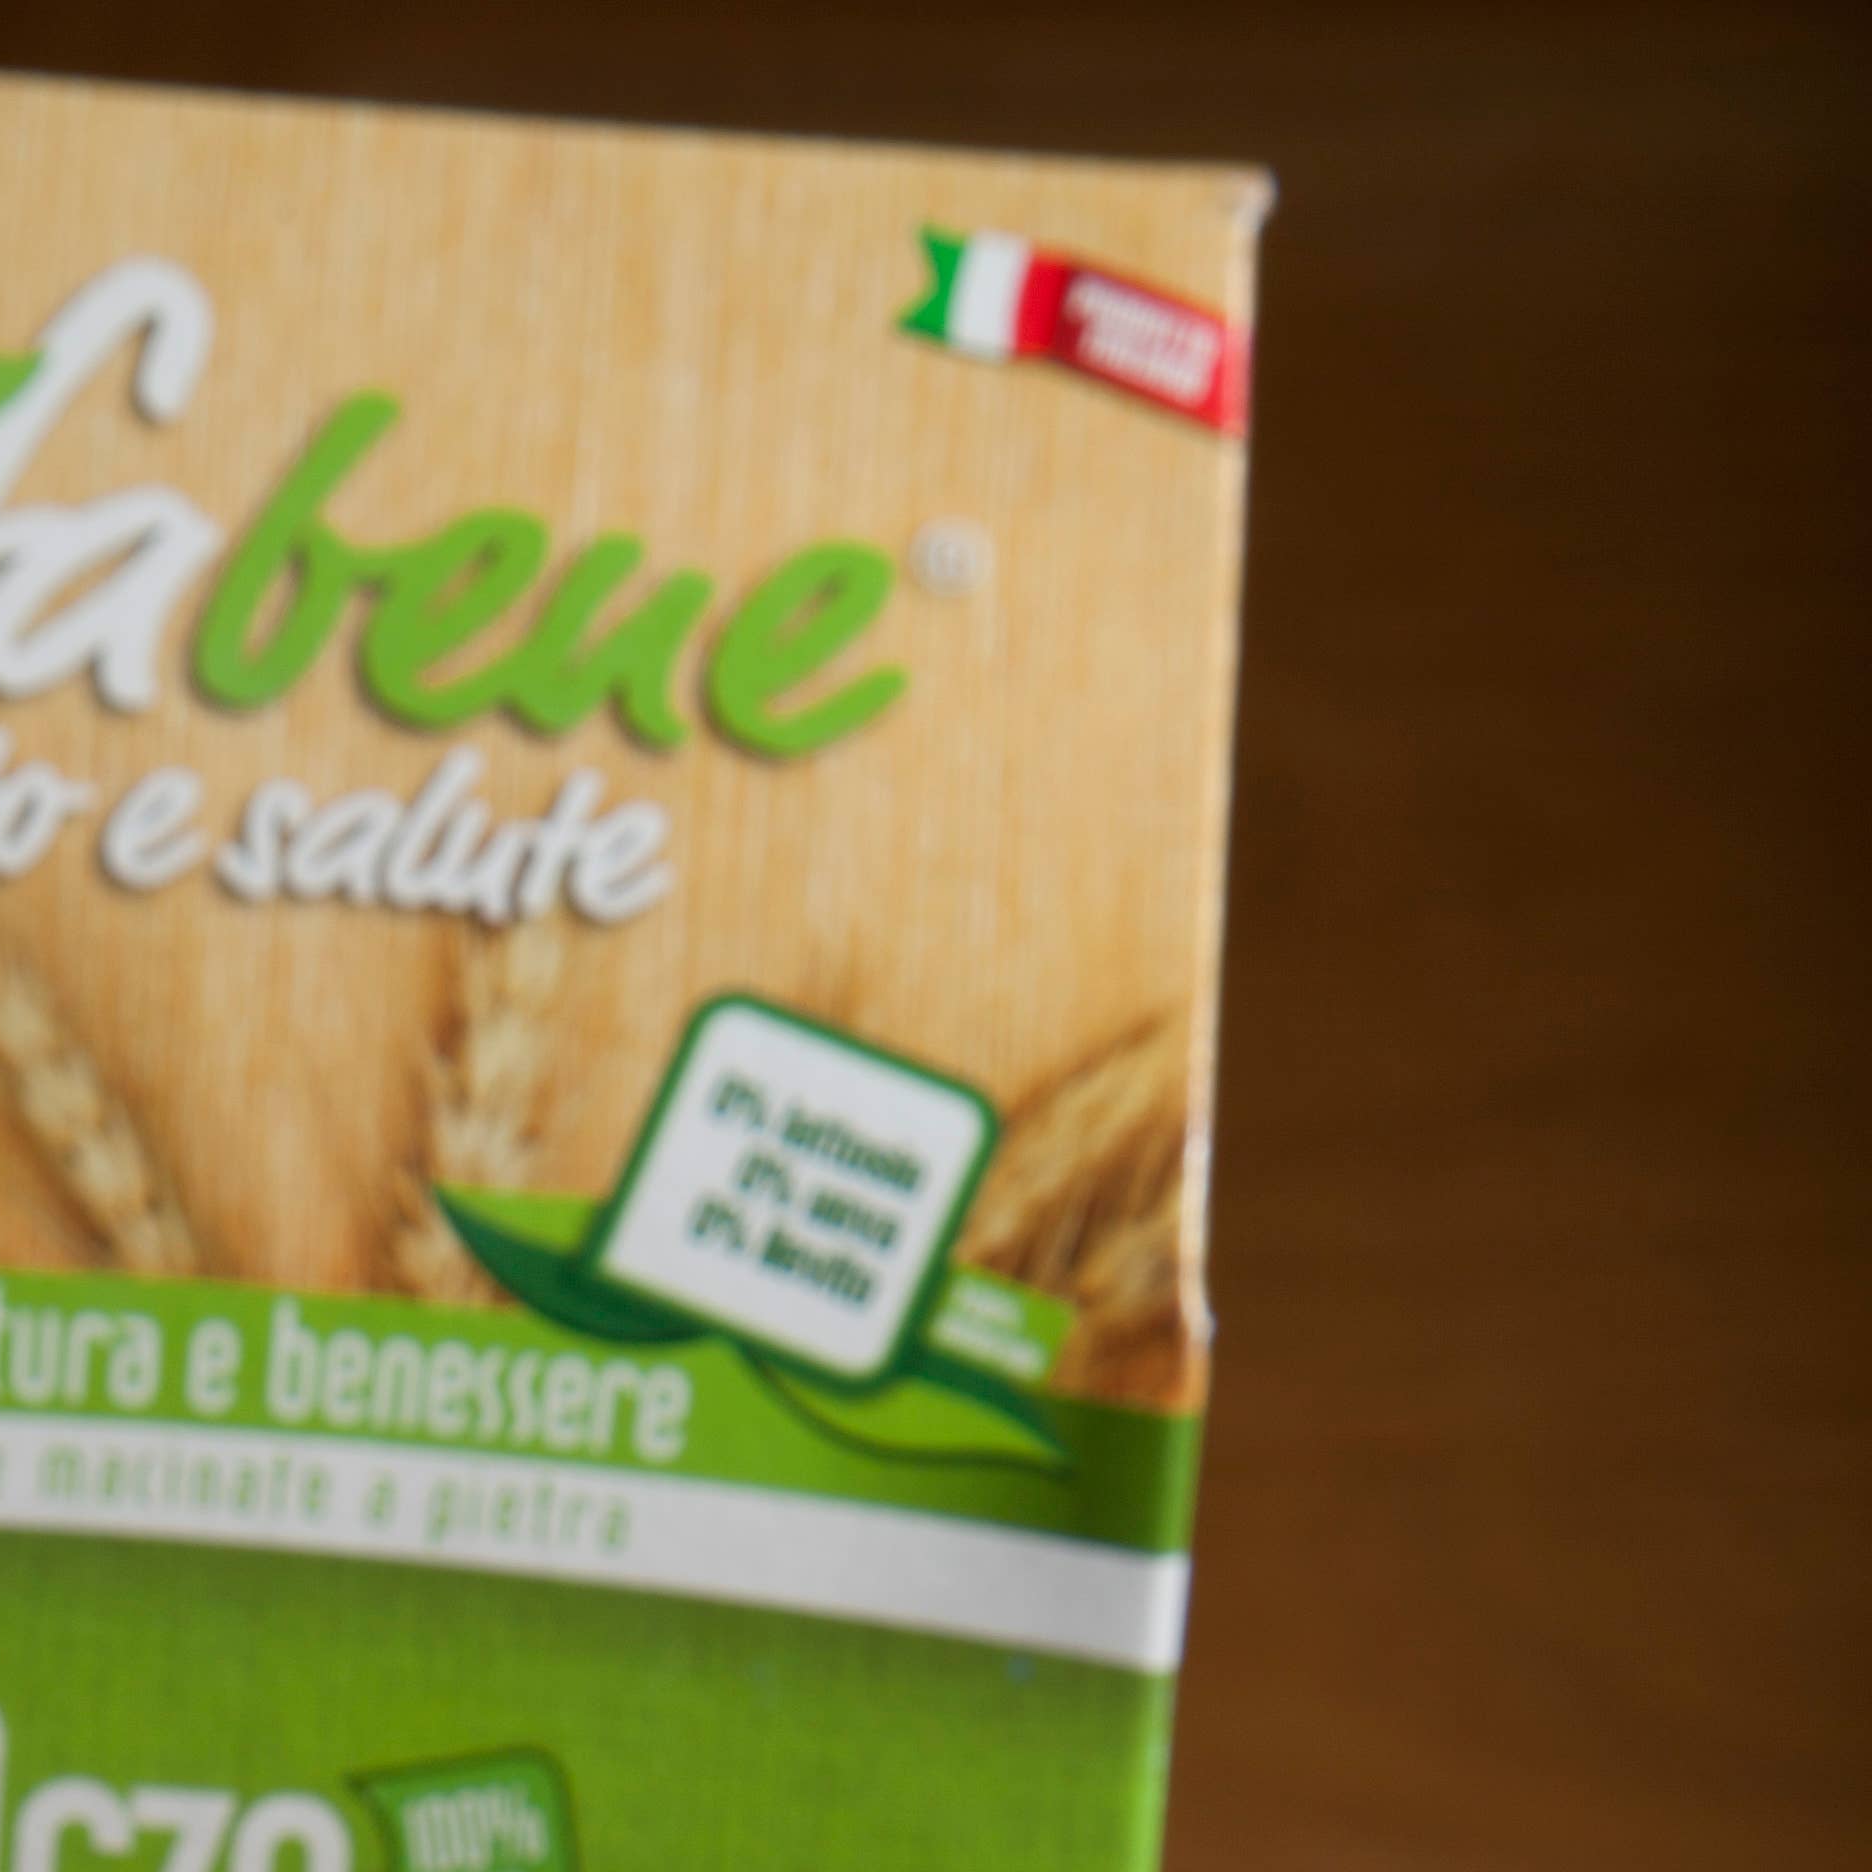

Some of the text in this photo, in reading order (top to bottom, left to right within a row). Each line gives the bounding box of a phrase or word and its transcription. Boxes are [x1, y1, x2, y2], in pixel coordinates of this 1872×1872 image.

[105, 765, 205, 889] e
[217, 746, 674, 924] salute
[185, 1319, 238, 1416] e
[266, 1298, 693, 1462] benessere
[35, 1437, 334, 1520] macinate
[362, 1475, 399, 1529] a
[426, 1469, 634, 1552] pietra
